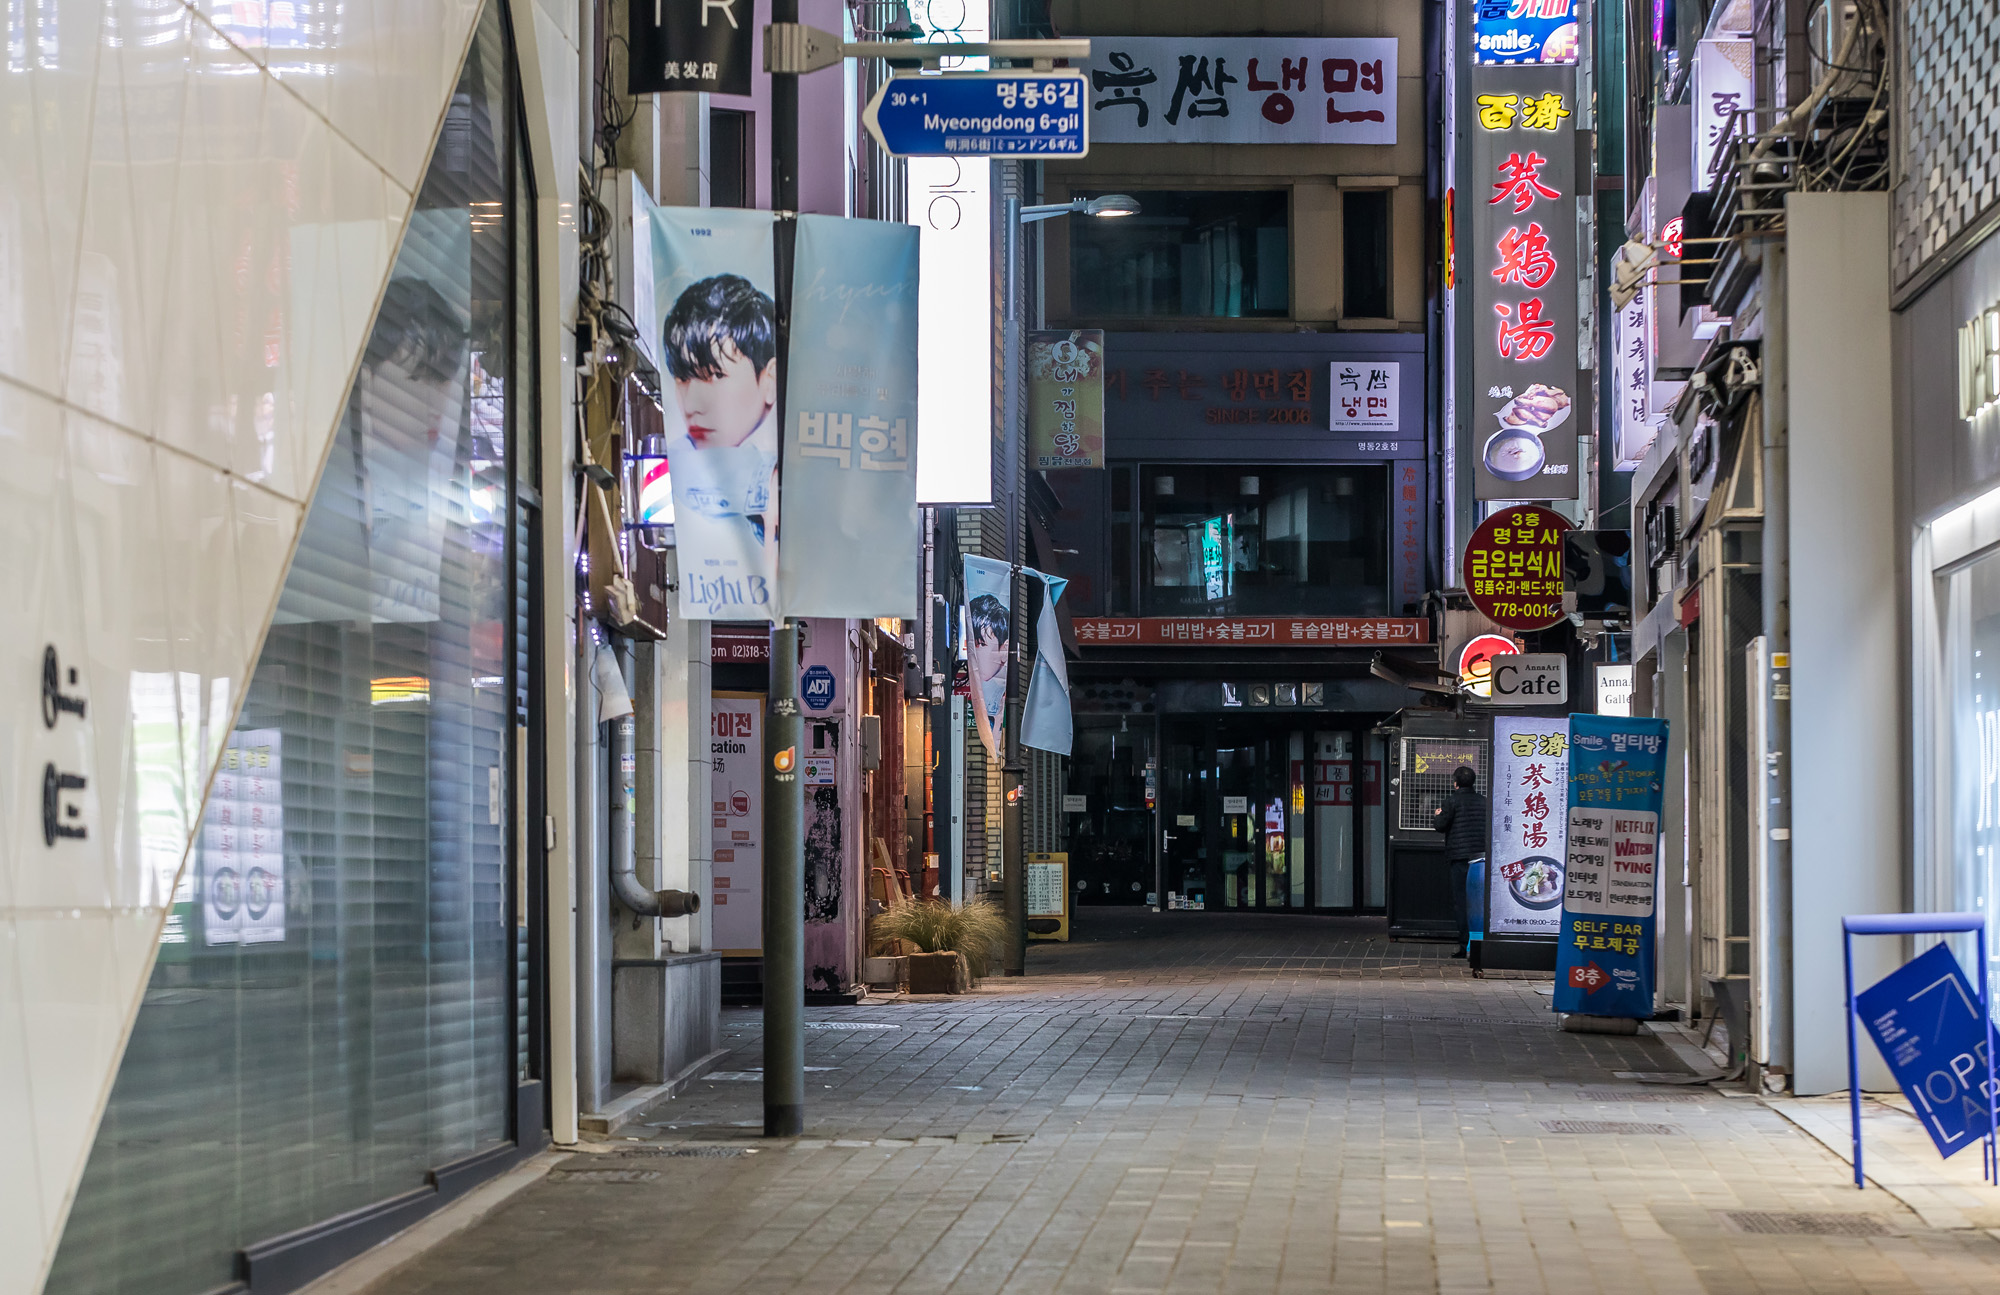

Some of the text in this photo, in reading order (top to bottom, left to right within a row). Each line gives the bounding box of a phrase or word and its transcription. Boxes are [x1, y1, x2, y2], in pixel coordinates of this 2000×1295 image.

[1478, 28, 1532, 50] smile
[1546, 35, 1576, 58] 3F
[664, 60, 718, 81] 美发店
[996, 81, 1079, 109] 명동6길
[1091, 51, 1386, 128] 육쌈냉면
[891, 92, 928, 107] 30 1
[923, 113, 1079, 133] Myeongdong 6-gil
[944, 138, 991, 152] 明洞6街
[690, 227, 712, 237] 1992
[1221, 367, 1313, 403] 냉면집
[1339, 367, 1390, 391] 육쌈
[1341, 396, 1388, 418] 냉면
[1205, 407, 1312, 426] SINCE 2006
[799, 411, 909, 472] 백현
[1357, 441, 1399, 451] 명동2호점
[1511, 513, 1541, 527] 3층
[1493, 528, 1560, 545] 명보사
[688, 573, 745, 615] Light
[1160, 621, 1276, 640] 비빔밥+숯불고기
[1289, 621, 1421, 641] 돌솥알밥+숯불고기
[807, 679, 831, 695] ADT
[1493, 664, 1561, 696] Cafe
[1222, 682, 1323, 707] LOOK
[1572, 734, 1604, 746] Smile
[1611, 733, 1663, 754] 멀티방
[1571, 817, 1604, 831] 노래방
[1614, 819, 1655, 835] NETFLIX
[1569, 854, 1605, 867] PC게임
[1613, 861, 1653, 875] TVING
[1567, 871, 1599, 885] 인터넷
[1566, 889, 1603, 904] 보드게임
[1573, 920, 1643, 936] SELF BAR
[1573, 935, 1640, 956] 무료제공
[1575, 968, 1601, 986] 3층
[1612, 967, 1638, 978] Smile
